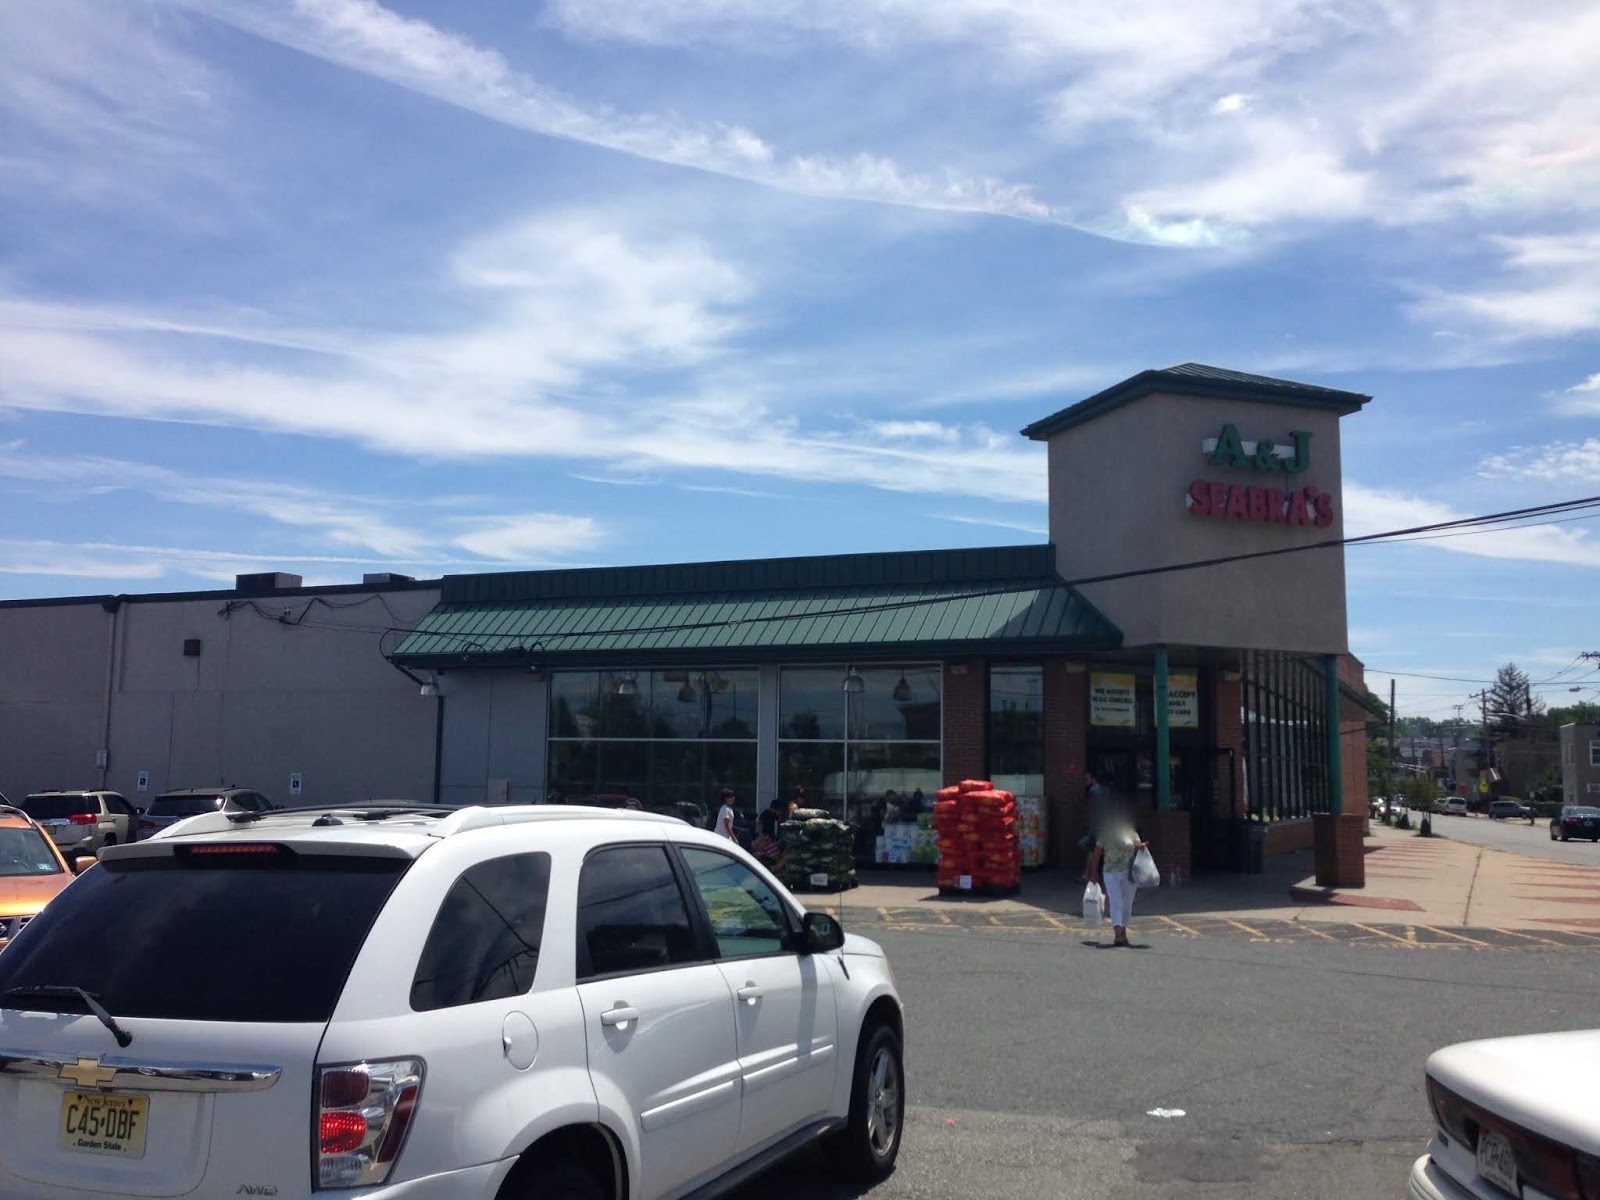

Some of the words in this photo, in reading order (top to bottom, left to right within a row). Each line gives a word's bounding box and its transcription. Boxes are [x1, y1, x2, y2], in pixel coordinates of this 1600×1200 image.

[1189, 479, 1333, 528] SEABRA'S
[84, 1094, 101, 1104] New
[101, 1096, 127, 1107] Jersey
[77, 1139, 102, 1148] Garden
[103, 1141, 122, 1151] State
[235, 1184, 278, 1196] AWD
